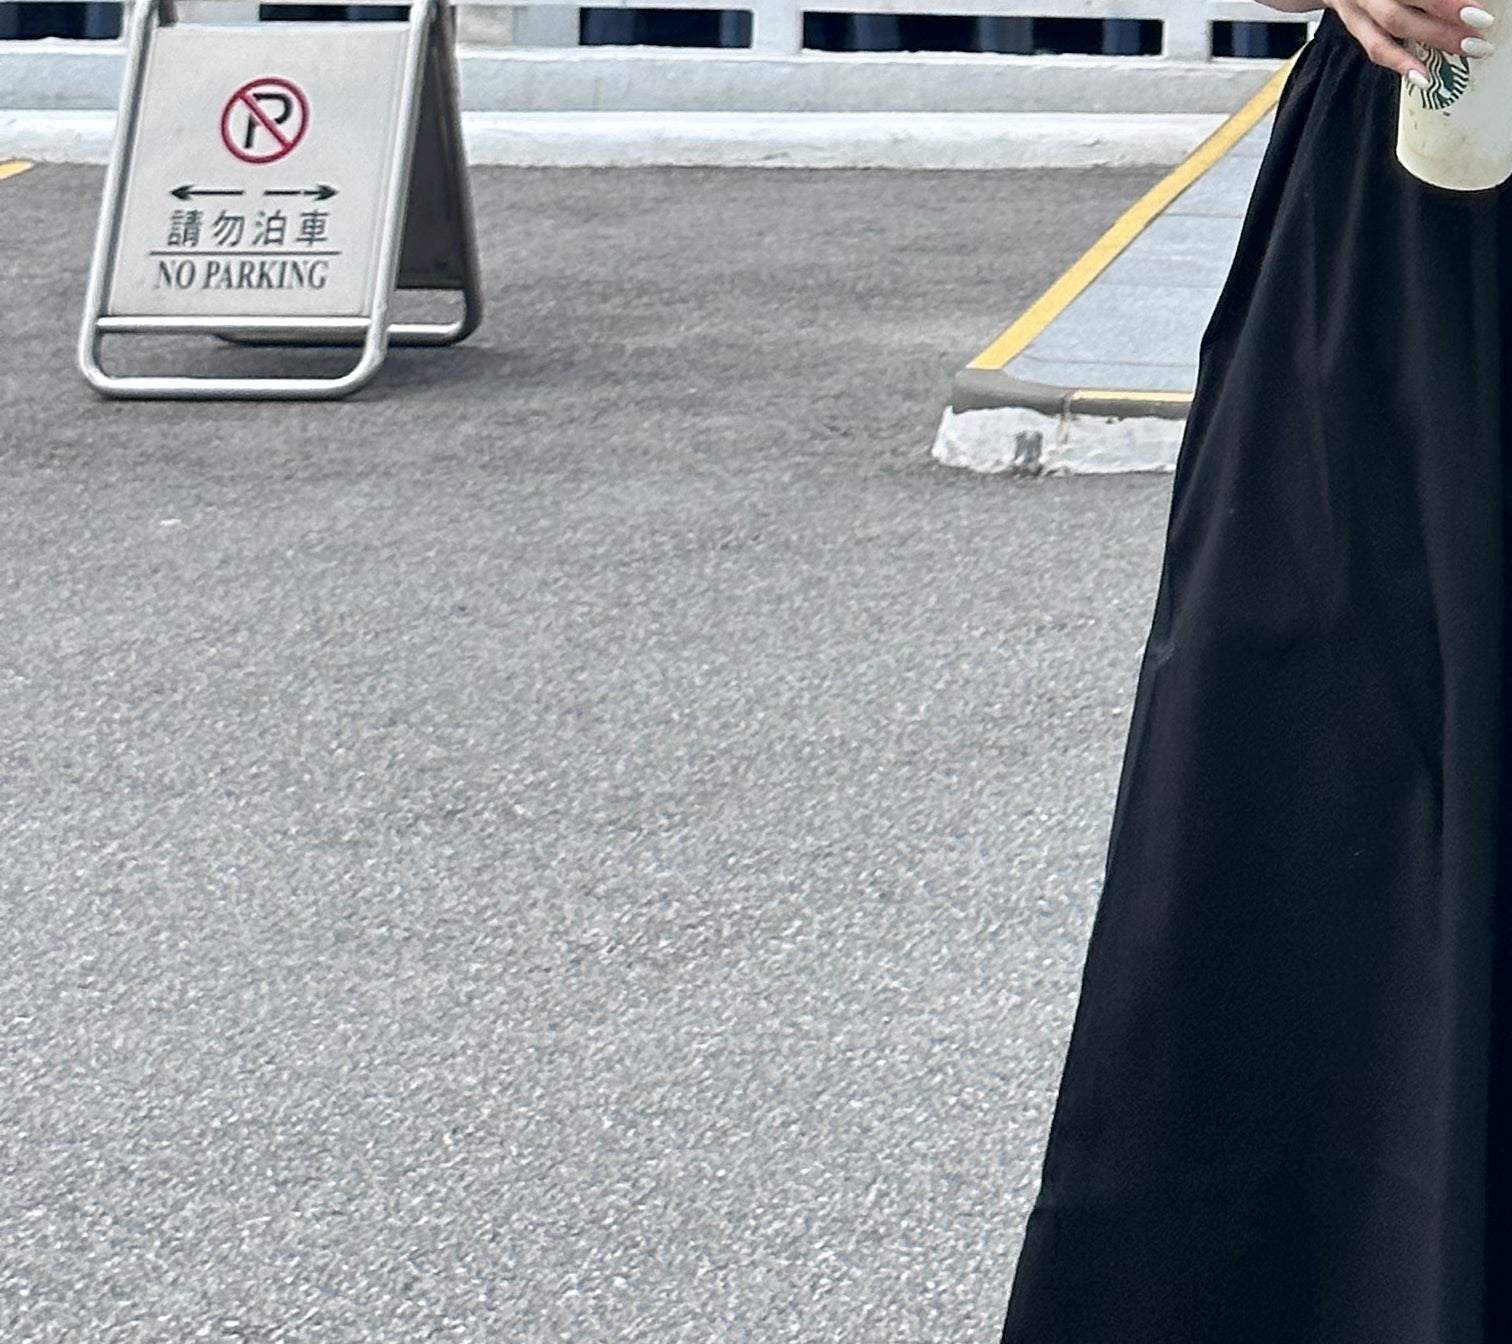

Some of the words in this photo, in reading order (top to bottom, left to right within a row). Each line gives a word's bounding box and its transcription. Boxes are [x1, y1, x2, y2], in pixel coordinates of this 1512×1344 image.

[244, 92, 293, 149] P
[167, 208, 329, 248] 請勿泊車
[152, 259, 196, 290] NO
[202, 259, 330, 290] PARKING
